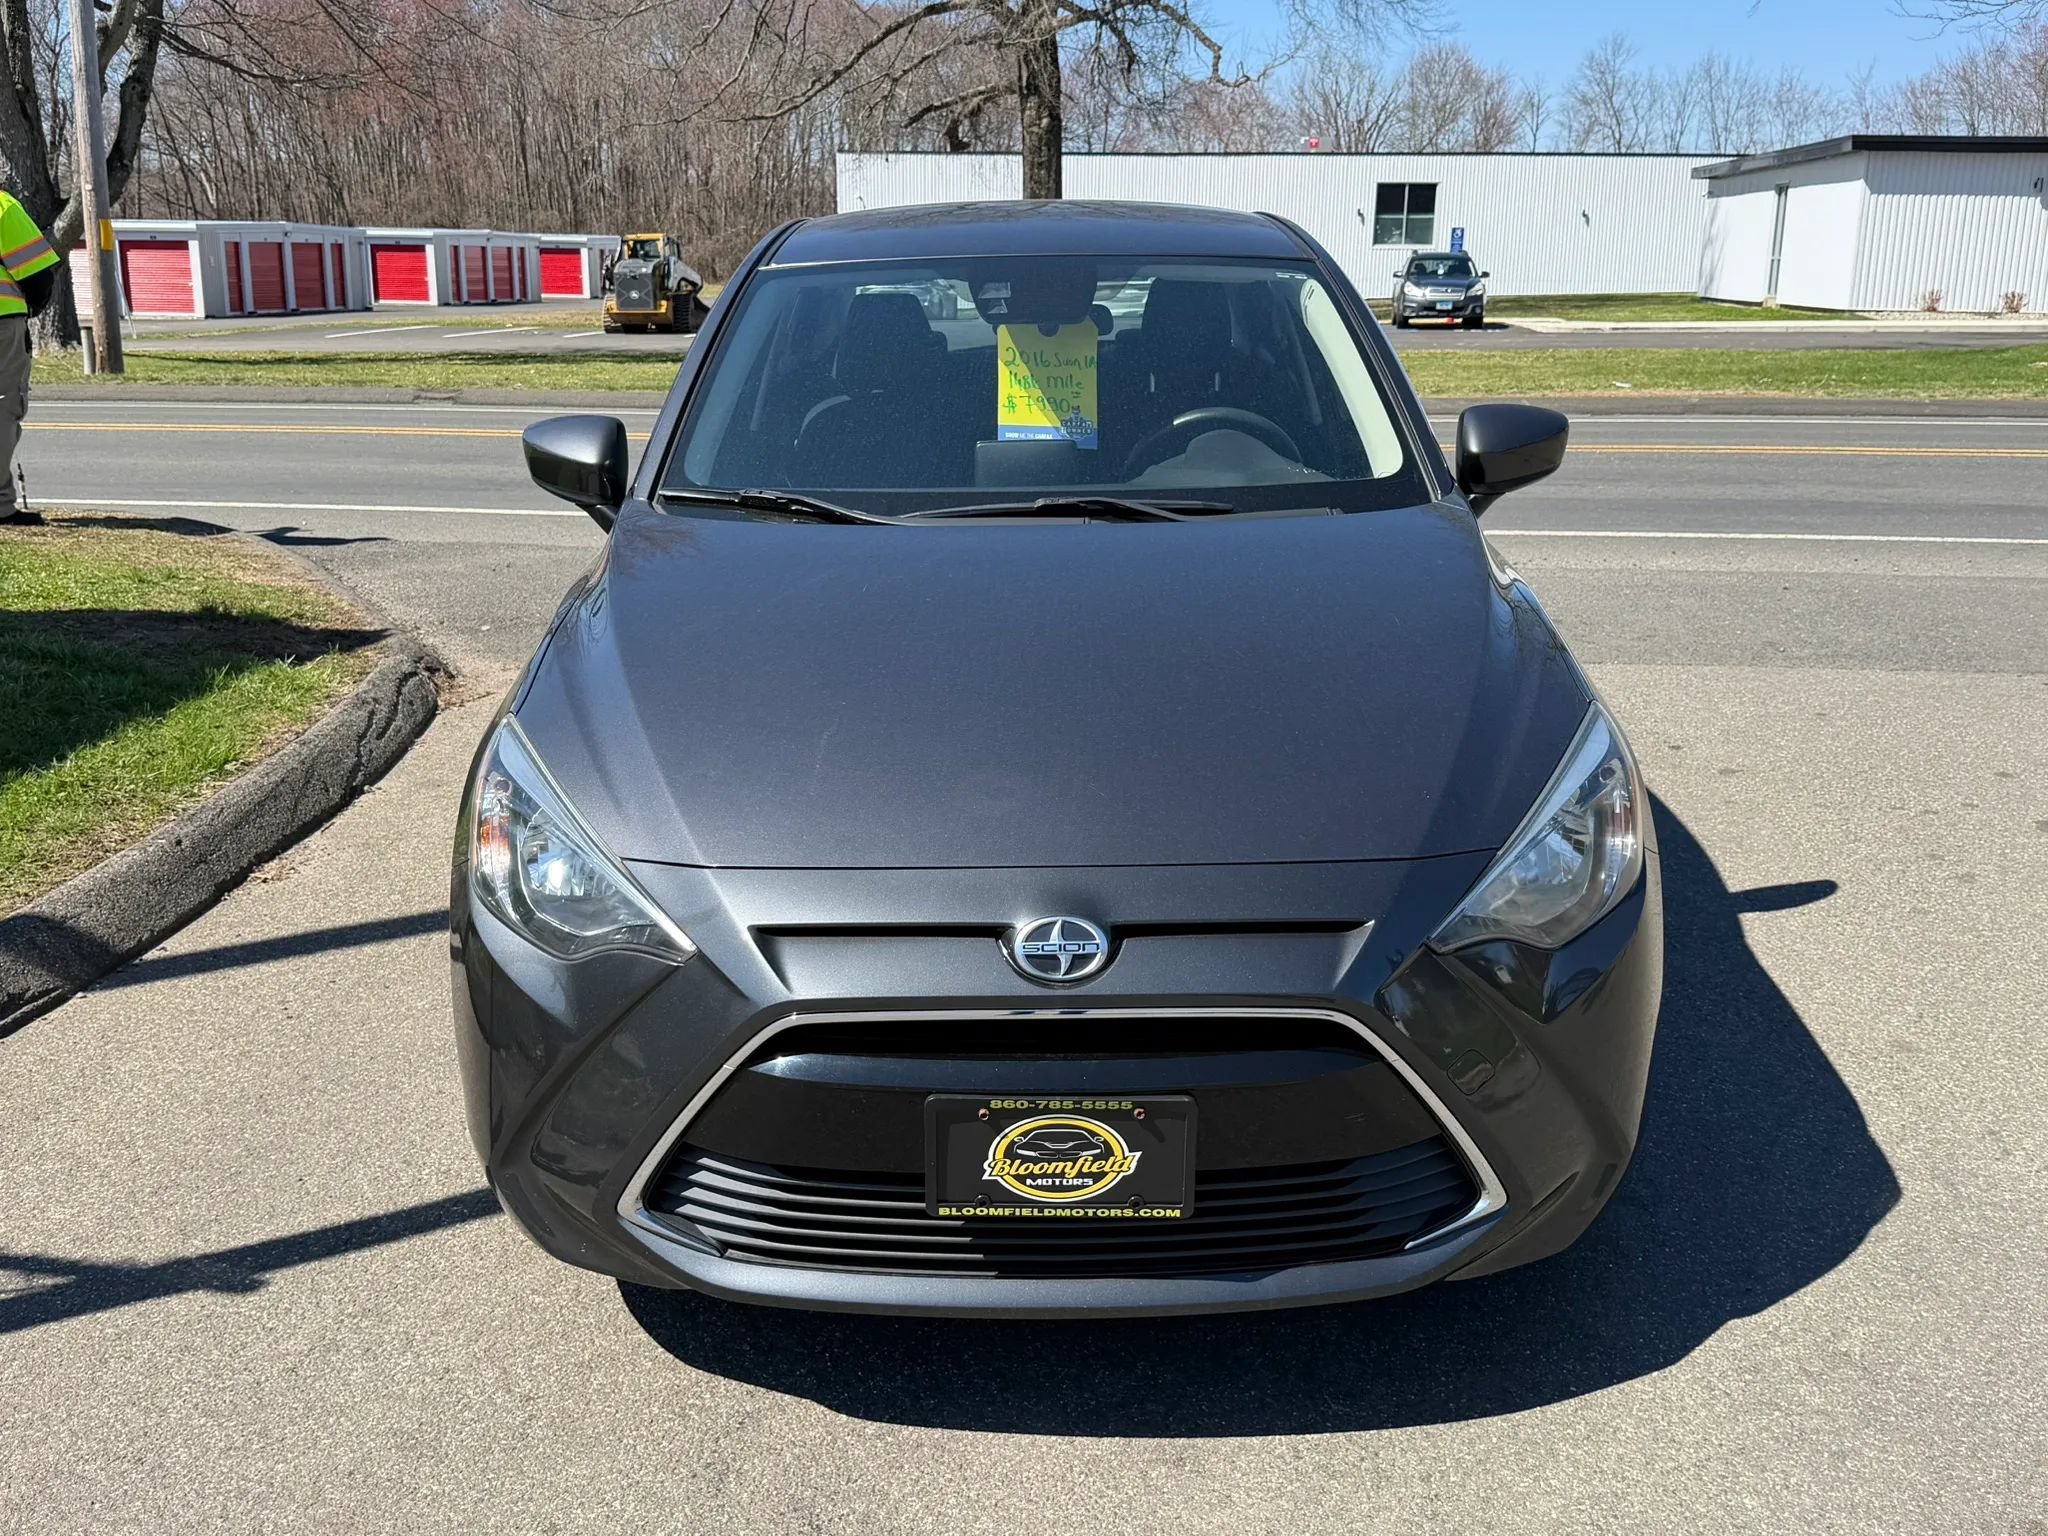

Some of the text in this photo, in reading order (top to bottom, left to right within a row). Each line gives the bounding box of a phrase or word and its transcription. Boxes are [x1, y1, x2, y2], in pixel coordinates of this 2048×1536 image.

[1004, 347, 1050, 369] 2016
[1022, 942, 1100, 953] SCION
[989, 1099, 1133, 1110] 860-785-5555
[989, 1153, 1136, 1178] Bloomfield
[1025, 1177, 1093, 1186] MOTORS
[938, 1206, 1181, 1218] BLOOMFIELDMOTORS.COM
